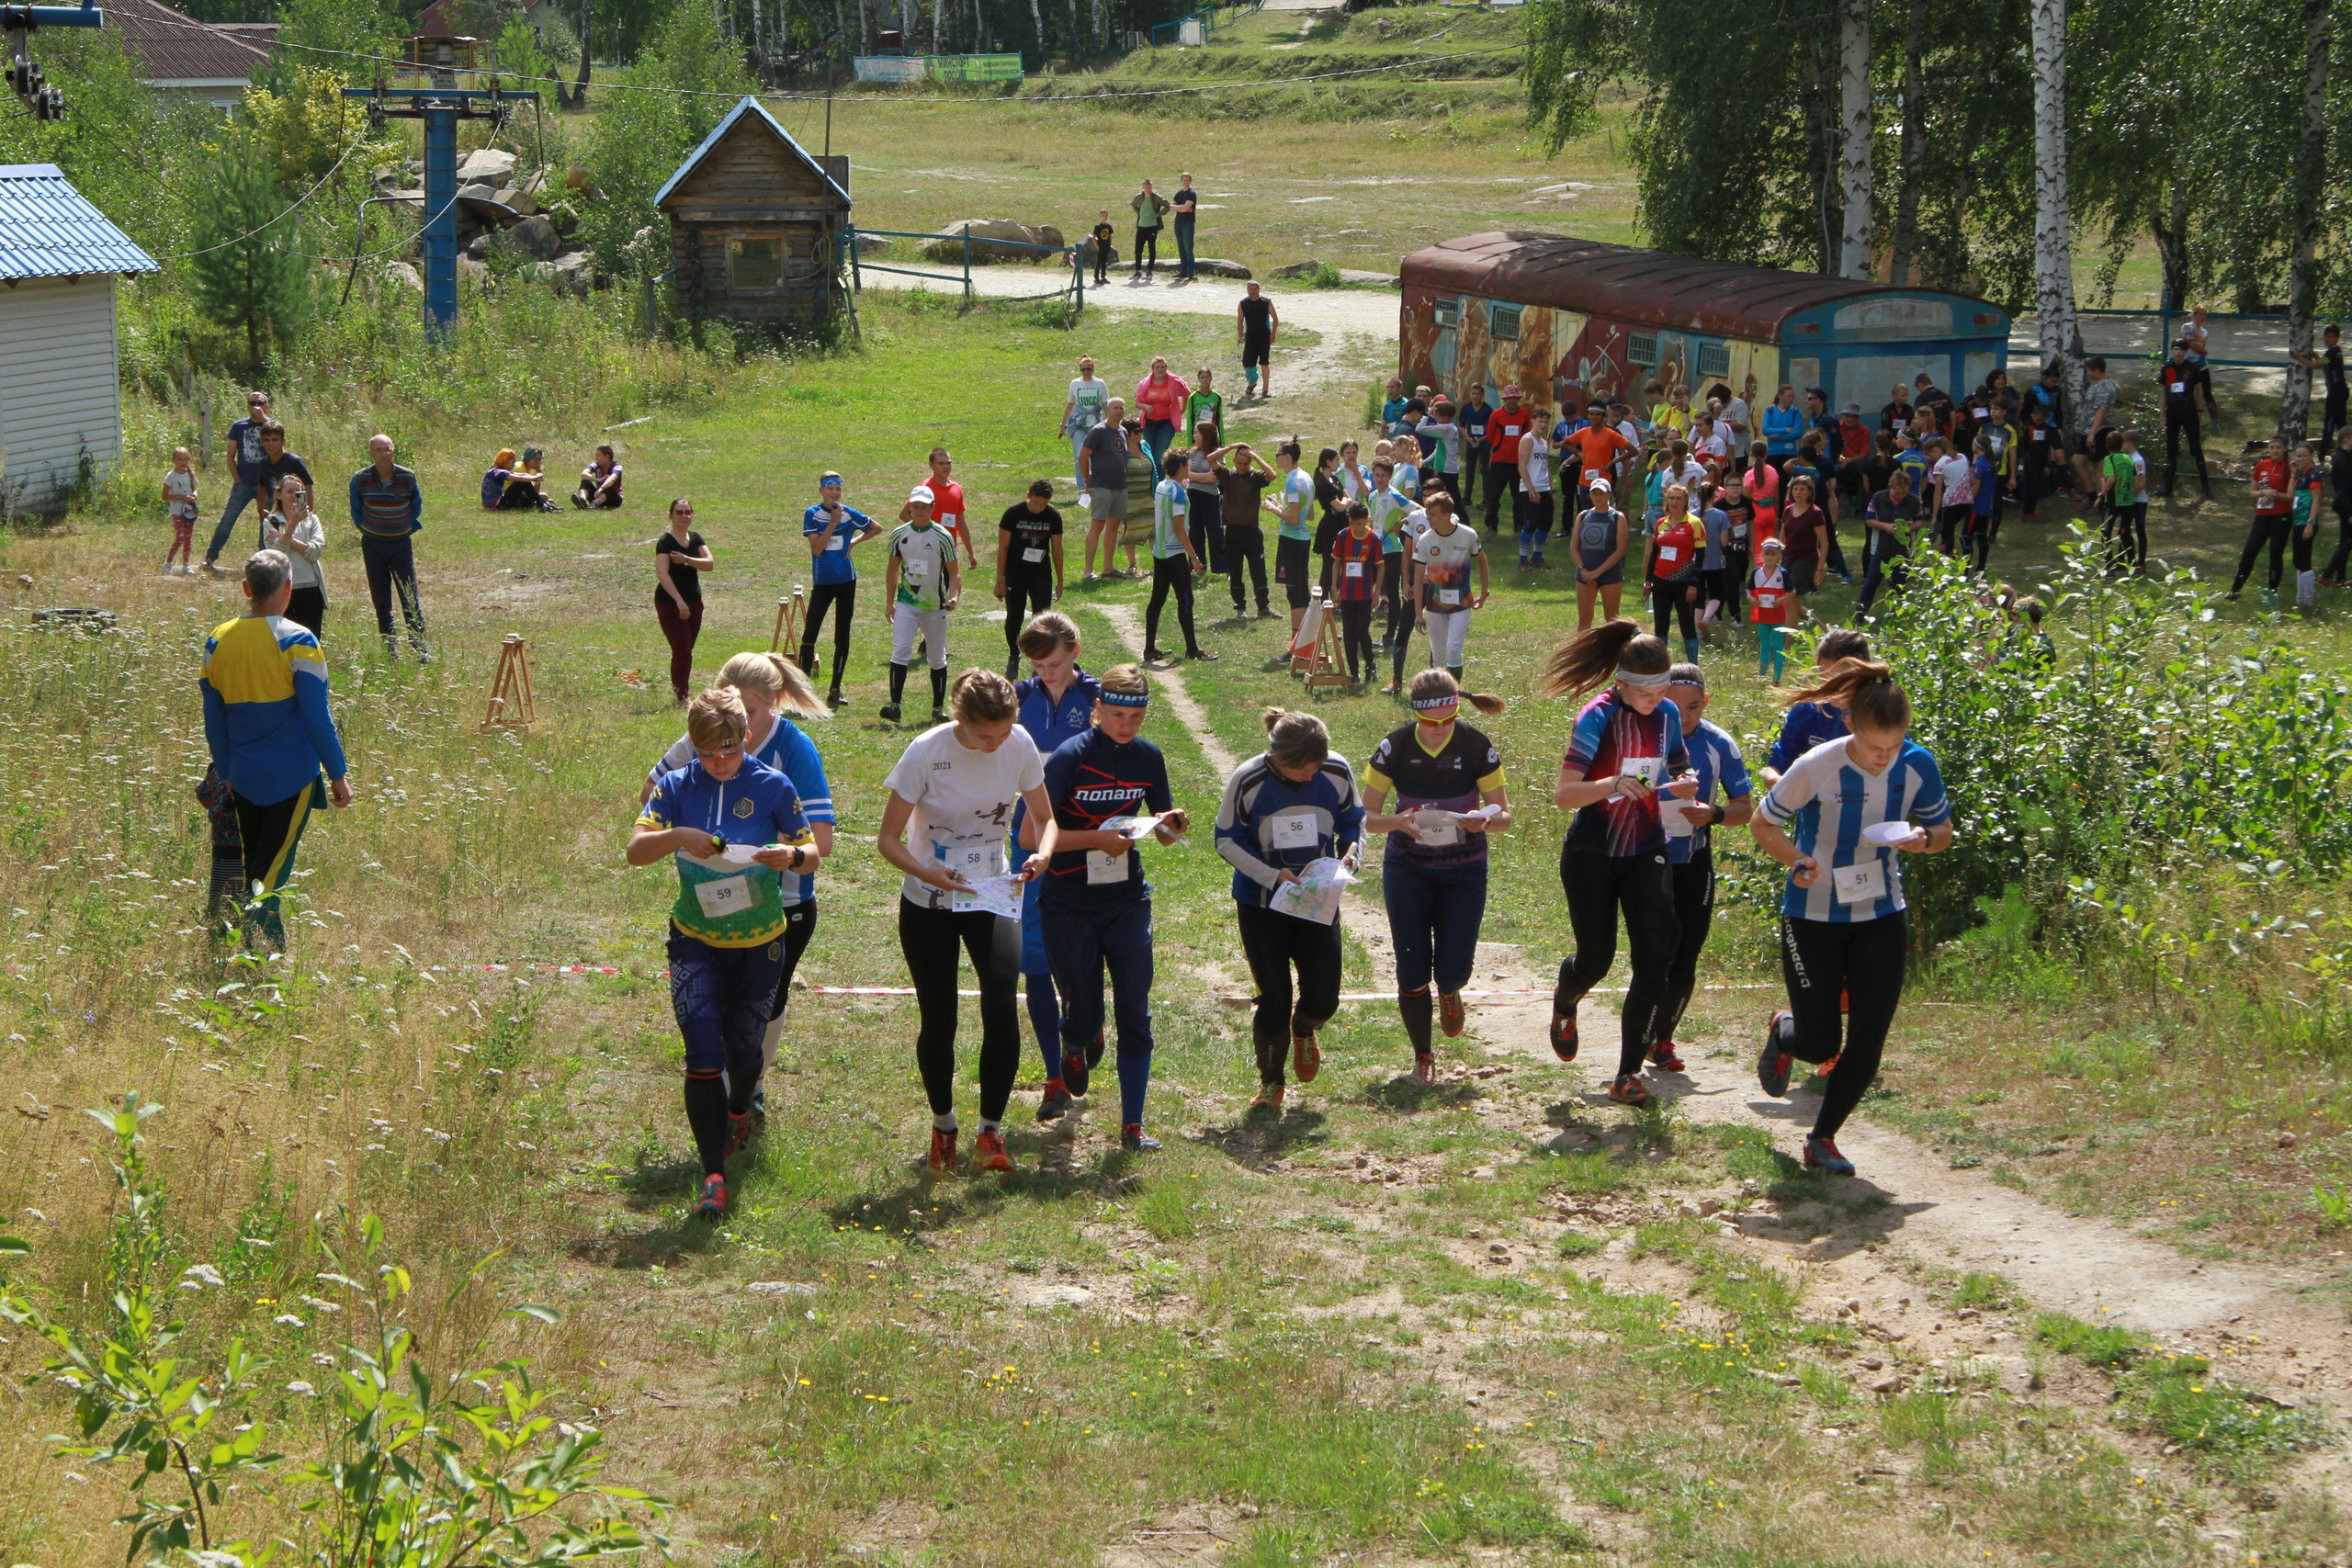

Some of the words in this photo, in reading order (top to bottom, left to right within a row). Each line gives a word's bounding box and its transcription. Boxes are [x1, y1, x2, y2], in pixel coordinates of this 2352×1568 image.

[933, 761, 952, 771] 2021
[1640, 766, 1650, 774] 53
[1290, 821, 1304, 831] 56
[967, 852, 980, 863] 58
[1855, 873, 1868, 885] 51
[717, 887, 731, 899] 59
